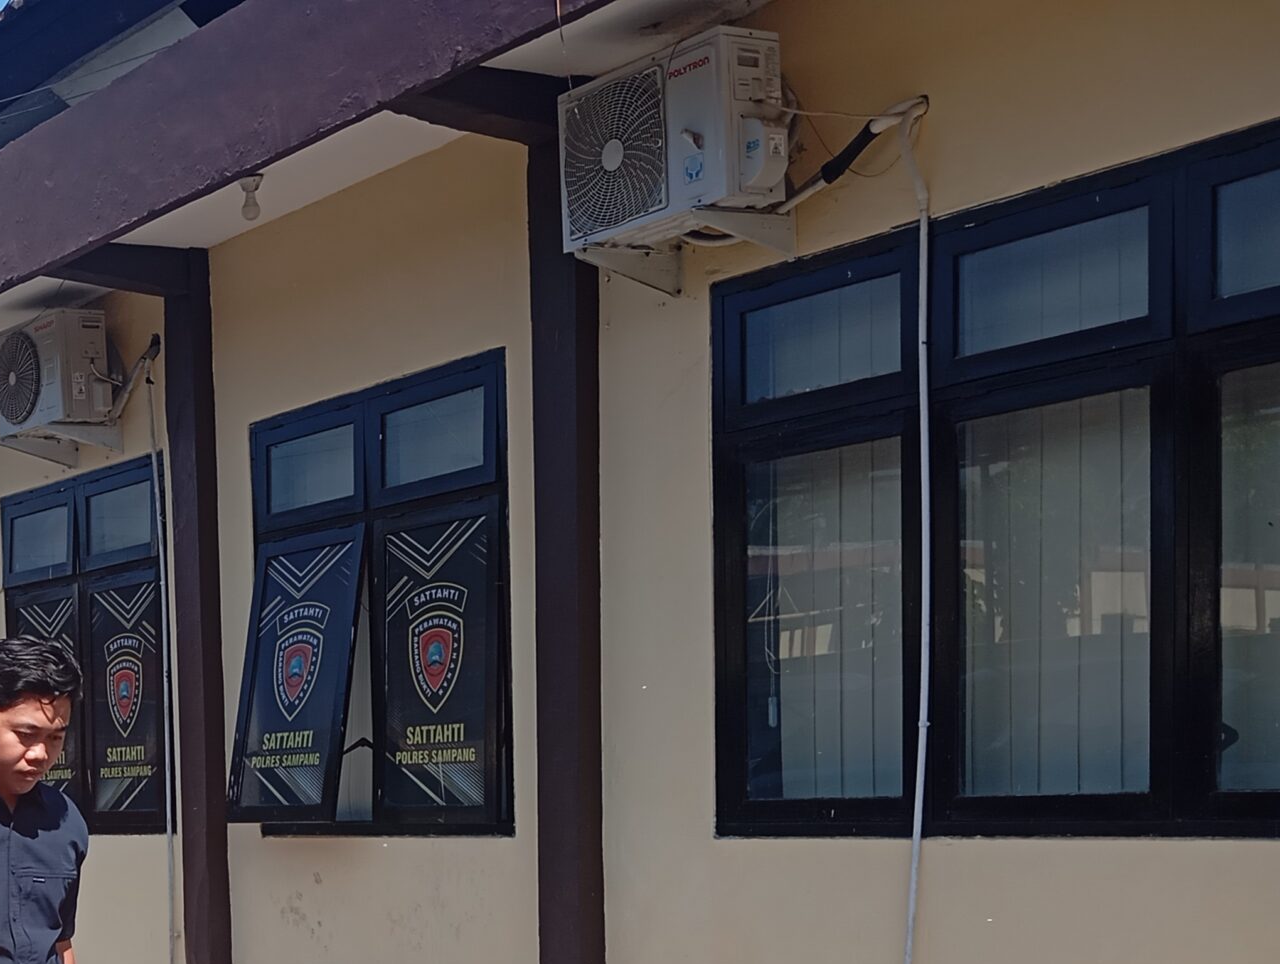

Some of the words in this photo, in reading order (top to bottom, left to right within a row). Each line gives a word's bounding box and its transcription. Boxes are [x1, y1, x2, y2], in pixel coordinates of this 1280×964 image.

[668, 56, 709, 80] POLYTRON
[414, 589, 459, 606] SATTAHTI
[284, 607, 323, 623] SATTAHTI
[415, 618, 458, 635] PERAWATAN
[109, 638, 139, 652] SATTAHTI
[262, 730, 313, 750] SATTAHTI
[406, 723, 464, 744] SATTAHTI
[106, 745, 145, 762] SATTAHTI
[251, 753, 280, 768] POLRES
[281, 752, 320, 767] SAMPANG
[395, 750, 429, 764] POLRES
[430, 747, 476, 763] SAMPANG
[100, 766, 123, 778] POLRES
[123, 765, 152, 777] SAMPANG
